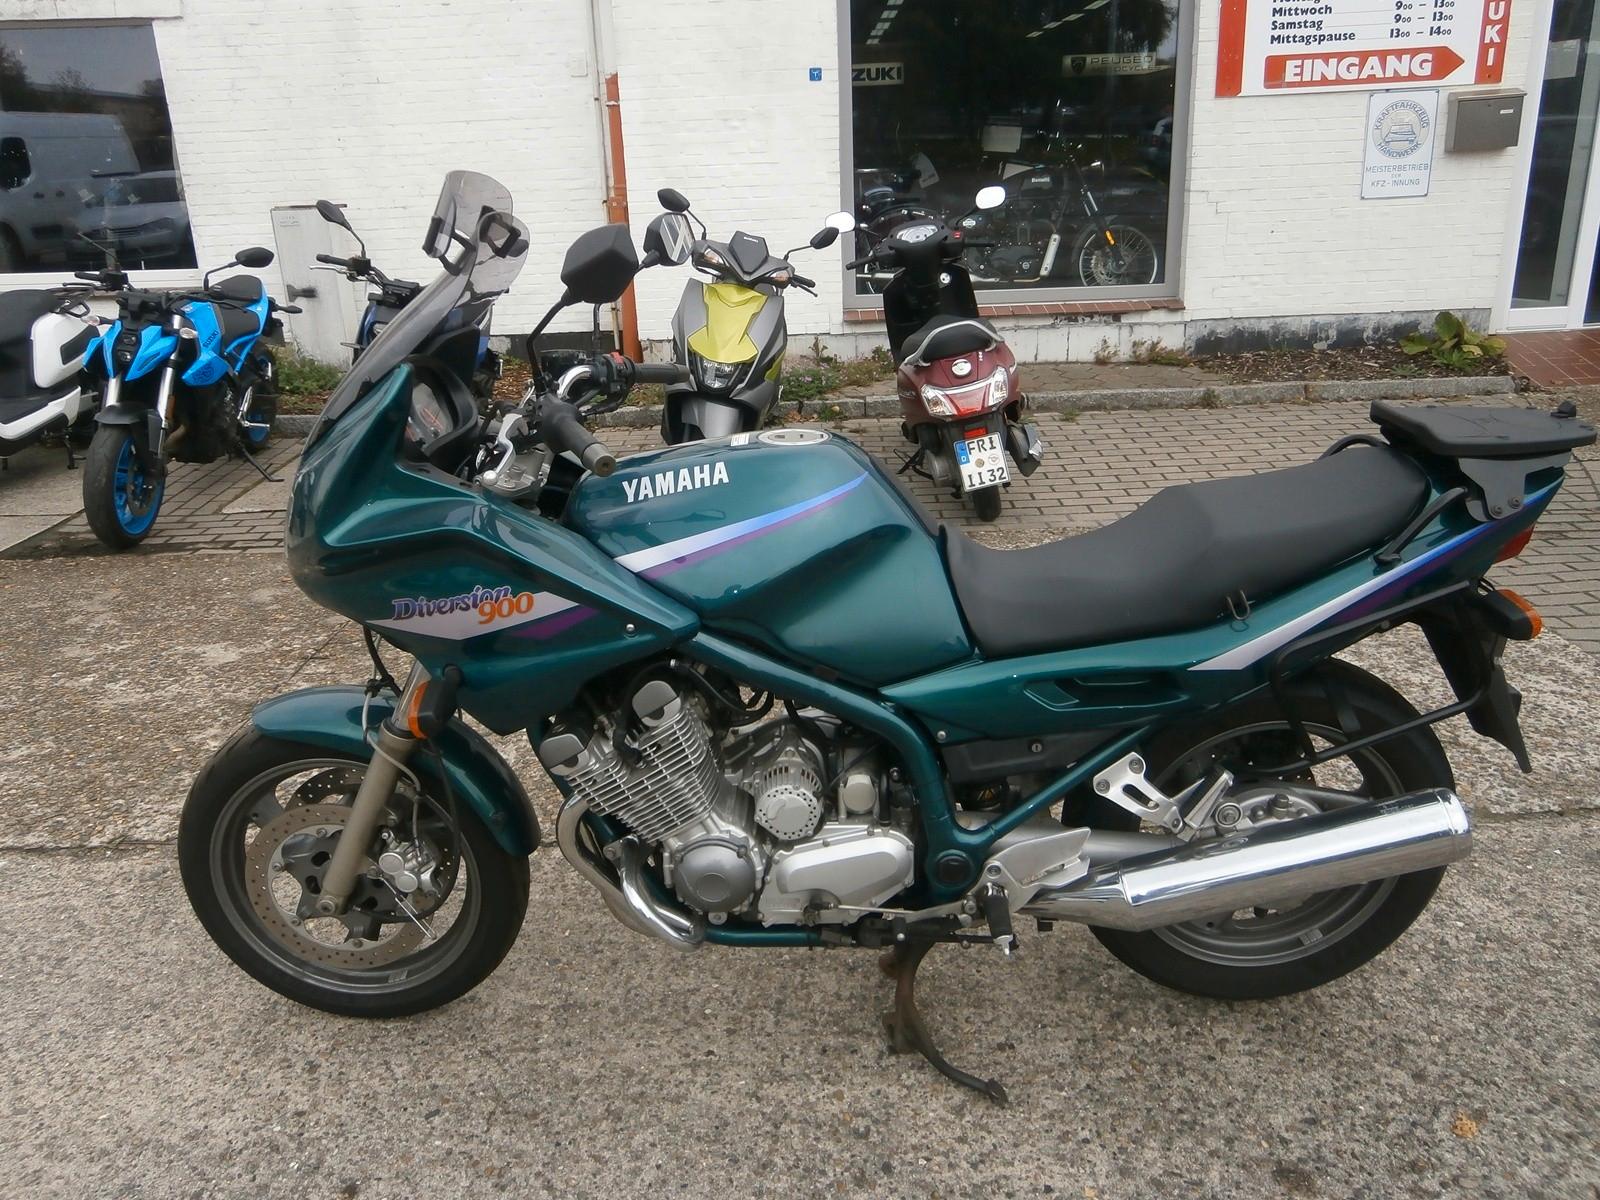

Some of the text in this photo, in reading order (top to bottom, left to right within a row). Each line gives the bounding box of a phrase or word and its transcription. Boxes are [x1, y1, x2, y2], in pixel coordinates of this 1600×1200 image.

[1271, 20, 1324, 31] Samstag
[1394, 14, 1412, 24] 900
[1432, 11, 1454, 22] 1300
[1272, 5, 1333, 17] Mittwoch
[1270, 32, 1356, 46] Mittagspause
[1389, 28, 1411, 39] 1300
[1429, 26, 1452, 37] 1400
[1284, 52, 1433, 83] EINGANG
[1374, 101, 1430, 130] KRAFTFAHRZEUG
[1377, 141, 1422, 158] HANDWERK
[1365, 163, 1429, 173] MEISTERBETRIEB
[966, 437, 996, 455] FRI
[622, 461, 729, 503] YAMAHA
[392, 585, 512, 621] Diversion
[478, 591, 534, 625] 900
